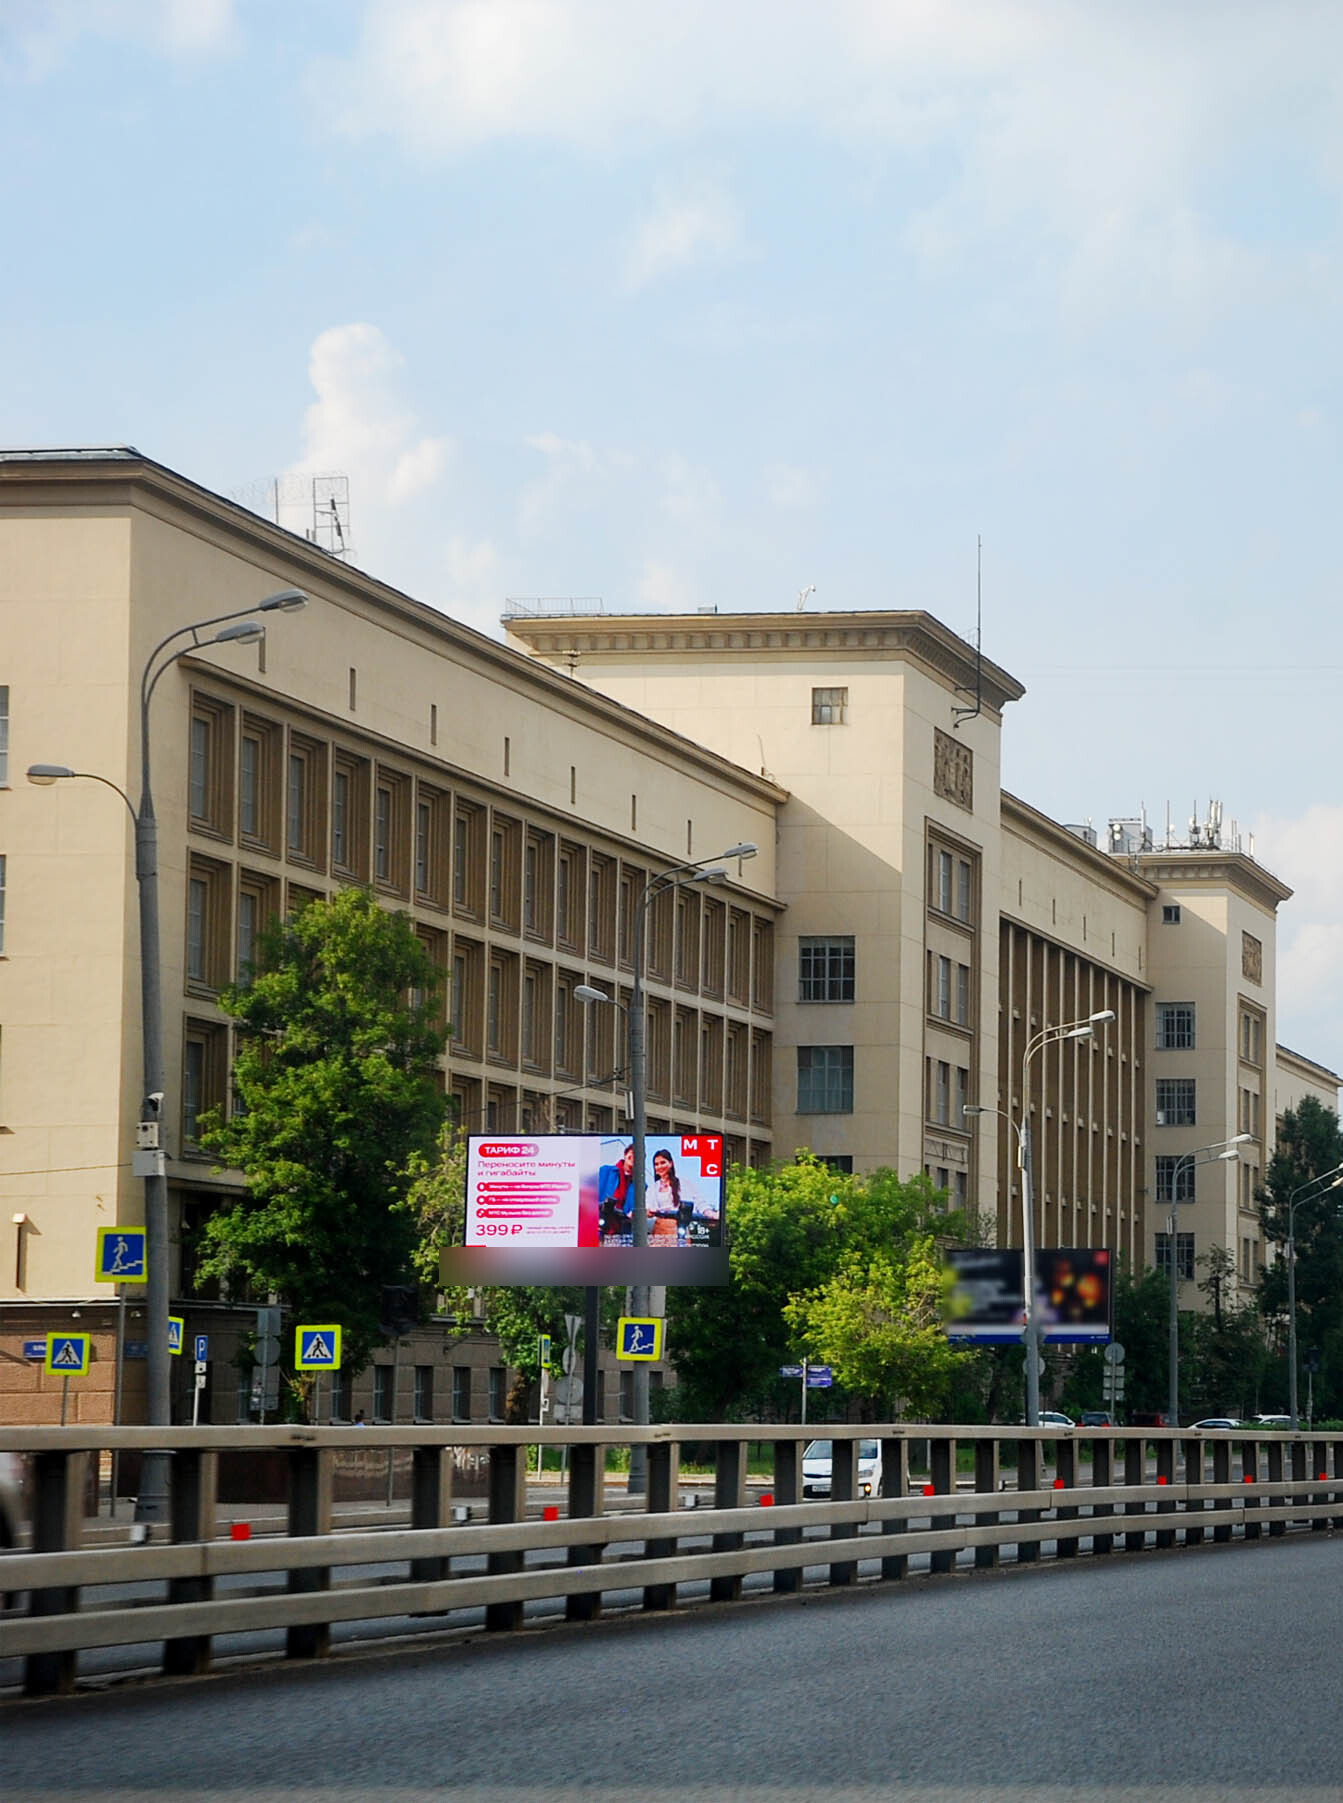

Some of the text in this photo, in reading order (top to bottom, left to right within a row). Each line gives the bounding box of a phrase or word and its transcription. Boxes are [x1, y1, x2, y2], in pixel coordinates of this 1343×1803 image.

[484, 1146, 534, 1155] ТАРИФ 24
[477, 1160, 536, 1169] Переносите
[485, 1169, 536, 1177] гигабайты
[476, 1224, 508, 1236] 399
